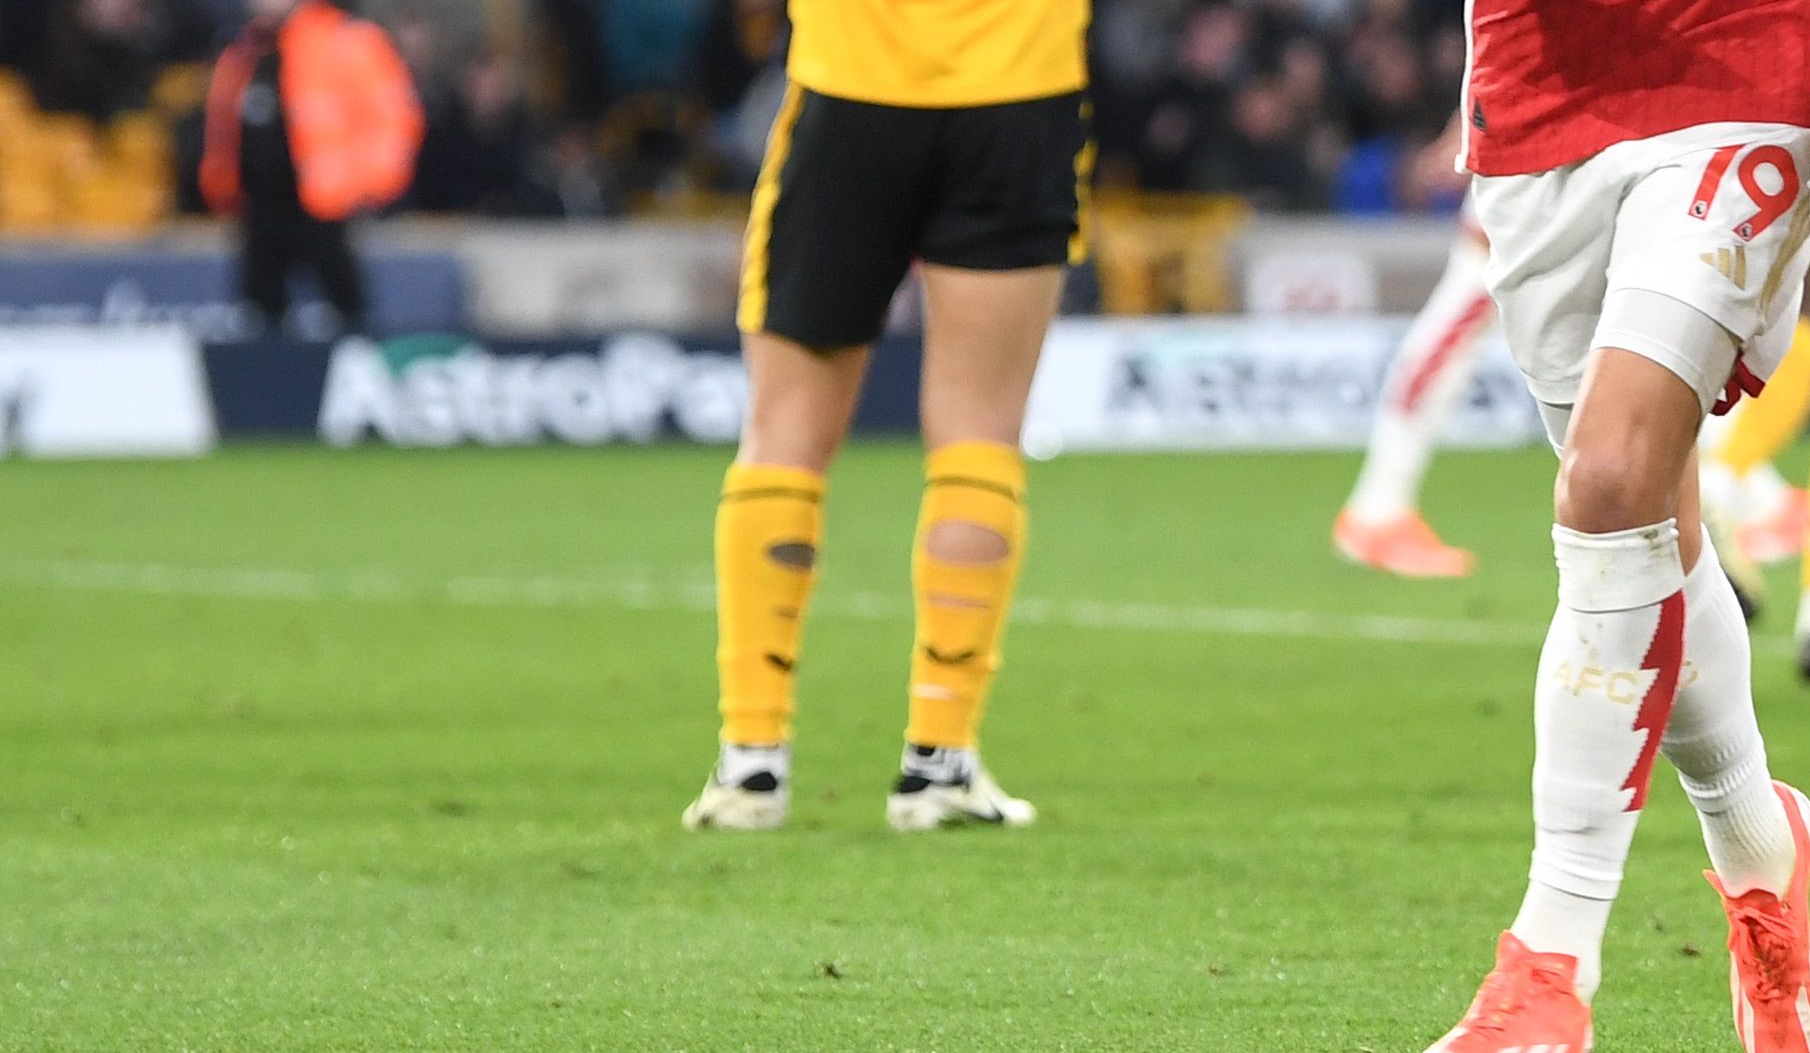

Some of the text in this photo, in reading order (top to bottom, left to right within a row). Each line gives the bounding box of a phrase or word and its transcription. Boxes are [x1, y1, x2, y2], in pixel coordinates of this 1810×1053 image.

[1688, 145, 1800, 242] 19
[318, 336, 750, 446] AstroPa
[1553, 659, 1640, 705] AFC
